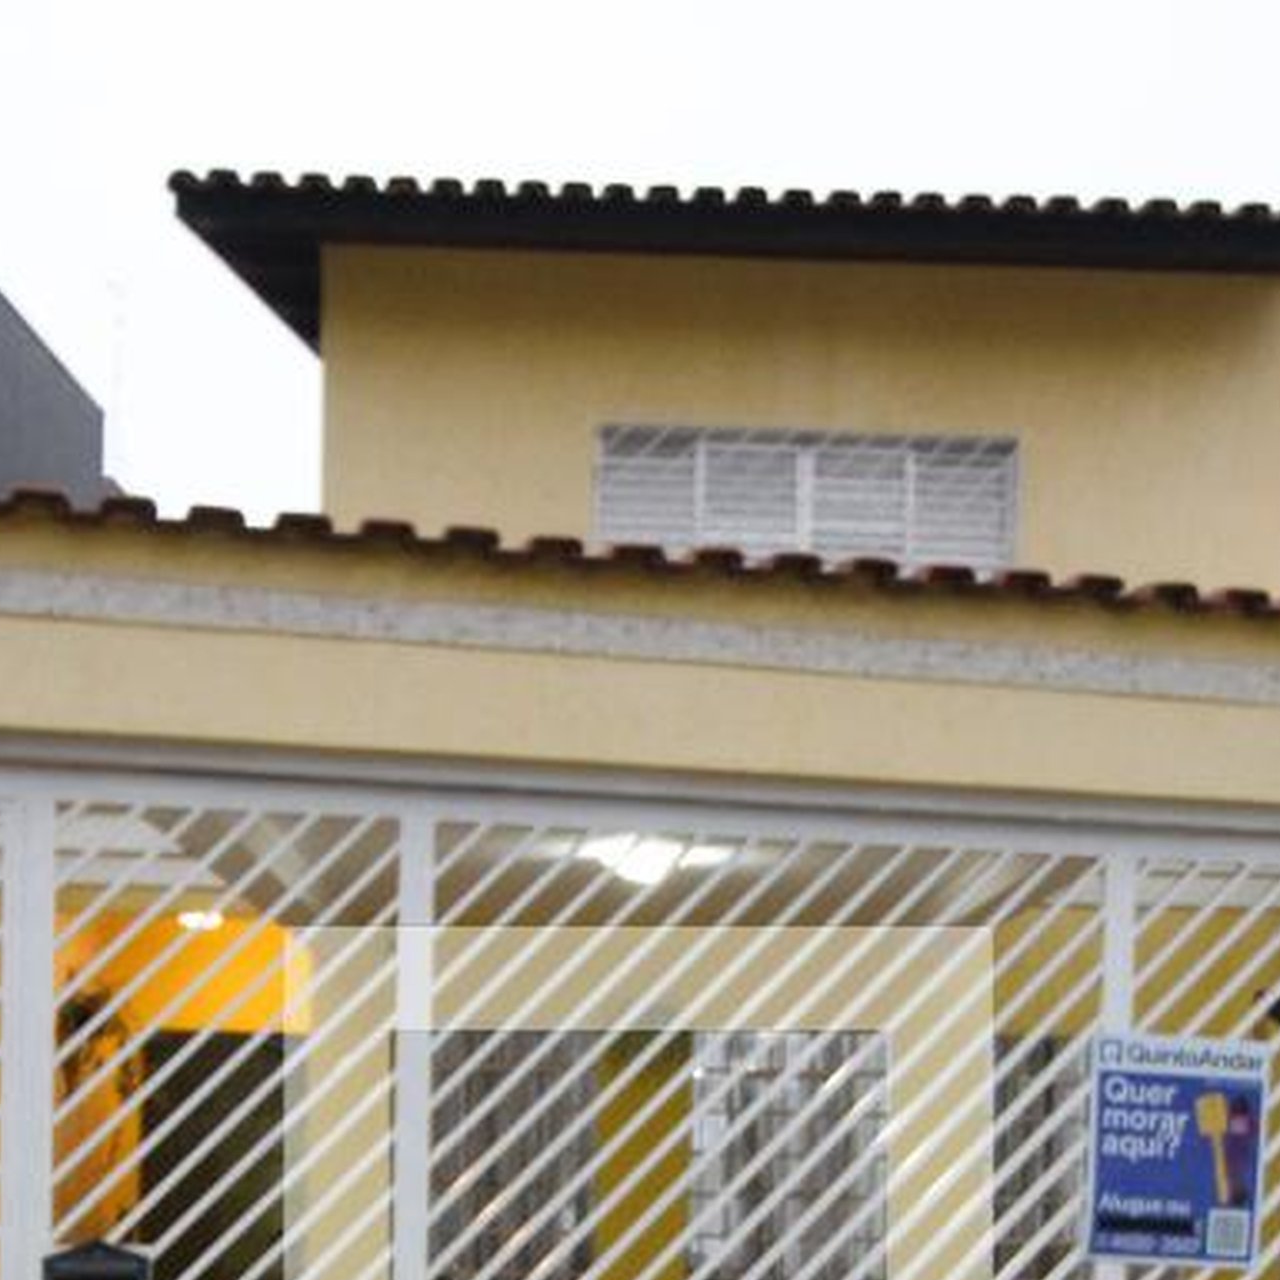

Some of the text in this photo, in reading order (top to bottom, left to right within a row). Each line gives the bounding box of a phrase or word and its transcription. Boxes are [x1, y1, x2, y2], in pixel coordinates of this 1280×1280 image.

[1128, 1042, 1263, 1071] QuintoAndar
[1104, 1076, 1178, 1106] Quer
[1101, 1106, 1189, 1134] morar
[1100, 1132, 1183, 1163] aqui?
